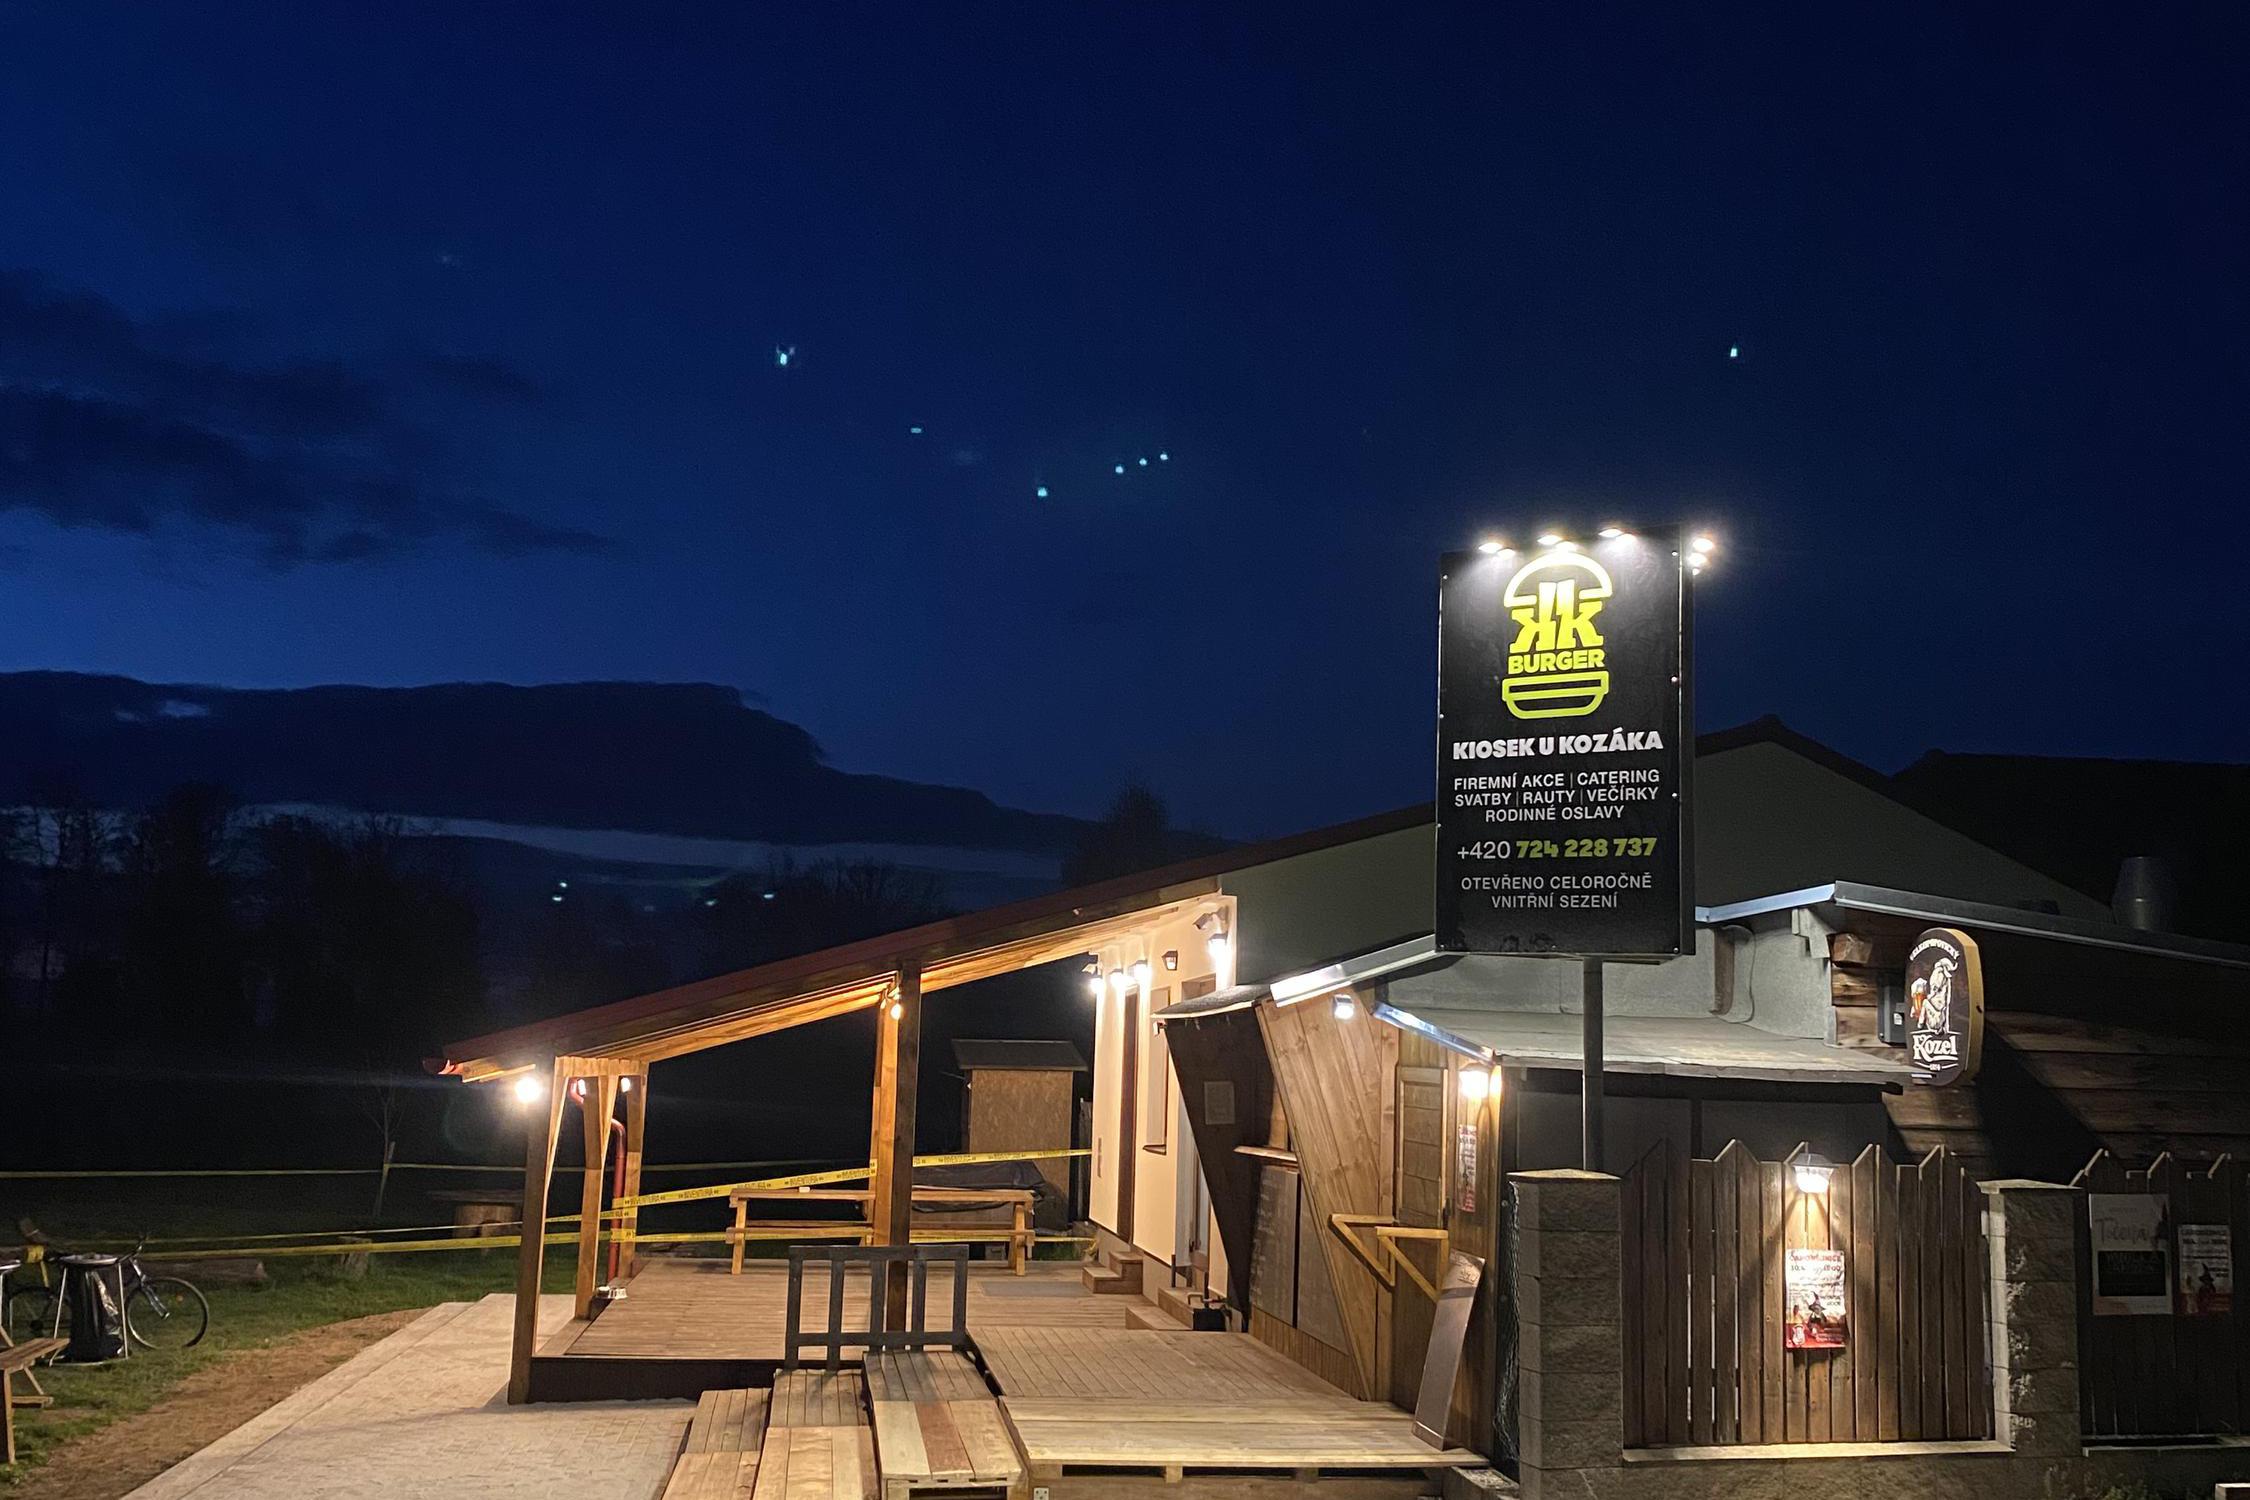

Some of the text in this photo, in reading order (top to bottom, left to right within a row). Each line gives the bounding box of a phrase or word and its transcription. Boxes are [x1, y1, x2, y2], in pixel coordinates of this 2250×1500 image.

[1508, 650, 1606, 675] BURGER
[1453, 727, 1664, 760] KIOSEK U KOZÁKA
[1454, 769, 1660, 791] FIREMNÍ AKCE CATERING
[1454, 785, 1659, 807] SVATBY RAUTY VEČÍRKY
[1485, 804, 1624, 822] RODINNÉ OSLAVY
[1457, 837, 1657, 859] +420 724 228 737
[1461, 872, 1652, 890] OTEVŘENO CELOROČNĚ
[1491, 891, 1618, 909] VNITŘNÍ SEZENÍ
[1912, 1034, 1959, 1062] Kozel
